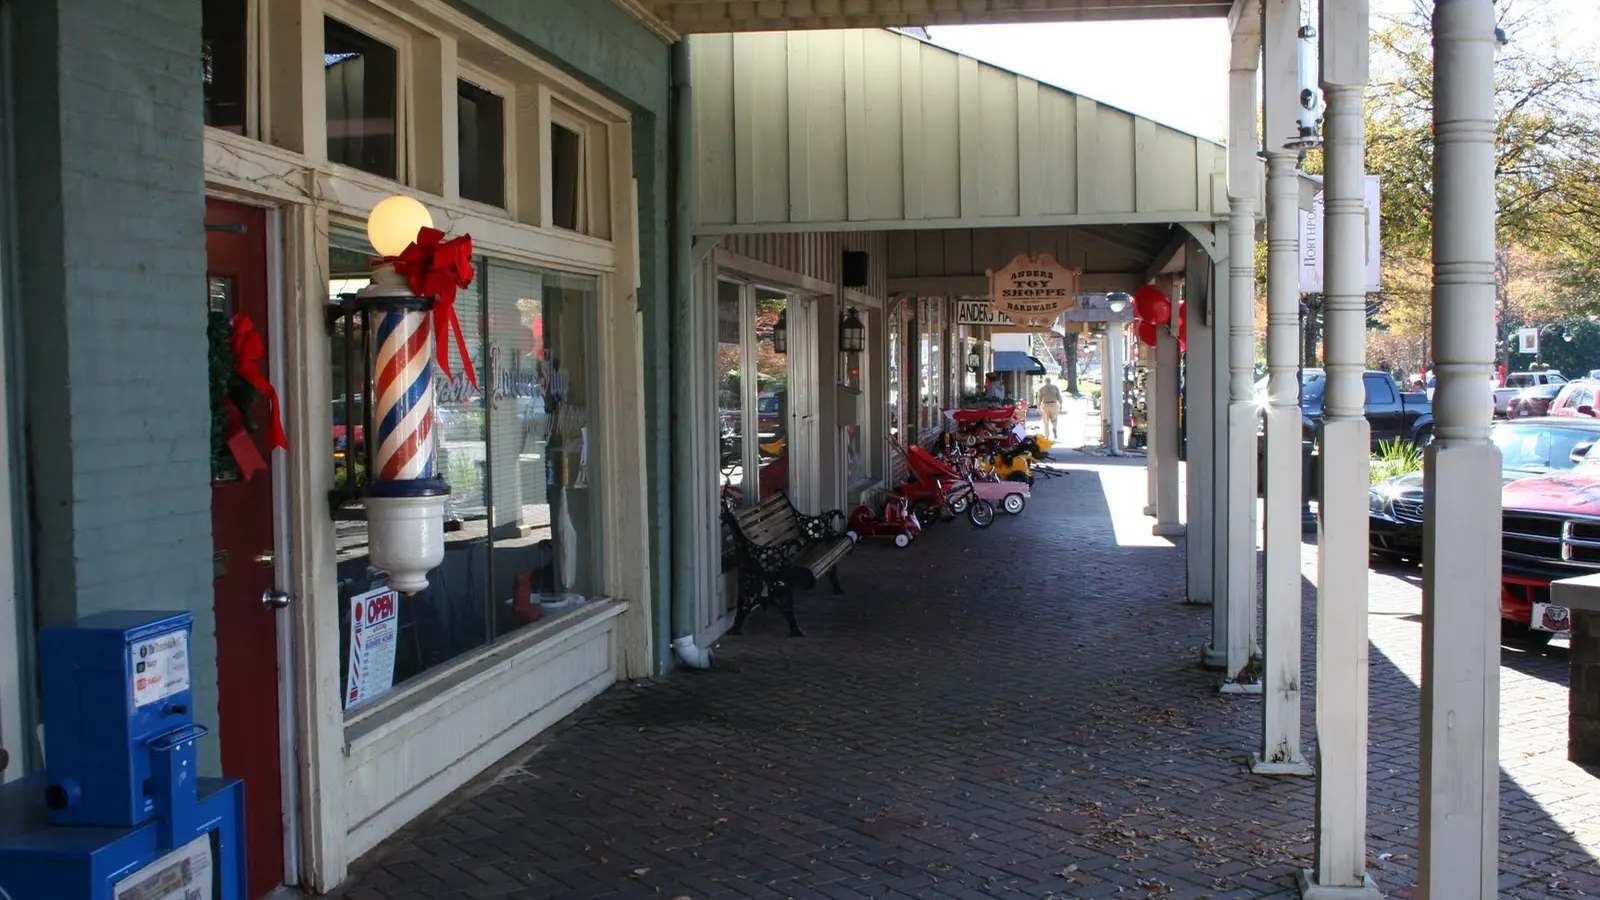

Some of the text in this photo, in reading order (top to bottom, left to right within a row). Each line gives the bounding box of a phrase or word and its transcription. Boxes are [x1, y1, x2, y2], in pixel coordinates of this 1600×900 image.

[1010, 270, 1054, 280] ANDERS
[1012, 280, 1051, 288] TOY
[1002, 288, 1066, 297] SHOPPE
[1007, 302, 1058, 312] HARDWARE
[368, 592, 394, 624] OPEN
